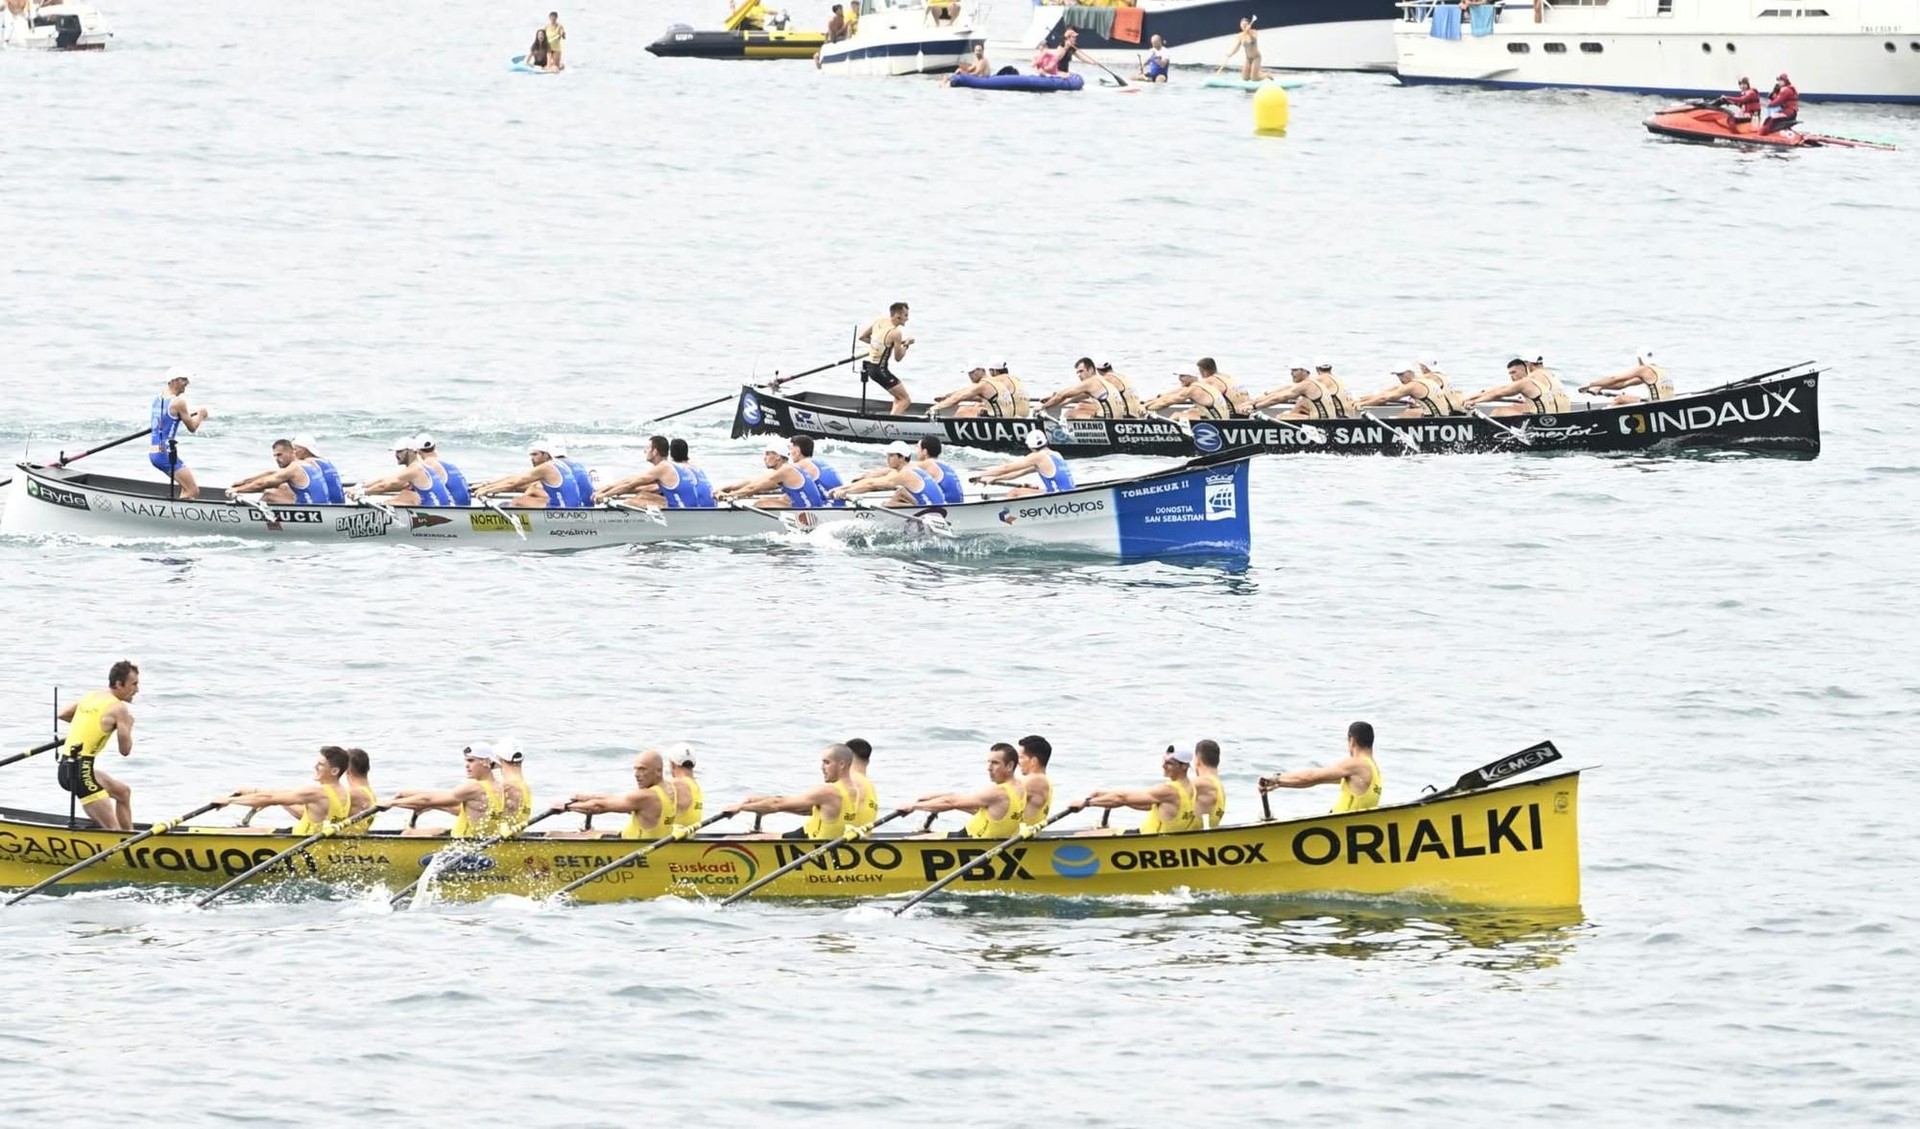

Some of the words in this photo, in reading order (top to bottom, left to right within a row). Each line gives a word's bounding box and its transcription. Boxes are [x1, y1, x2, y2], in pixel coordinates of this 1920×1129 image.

[1650, 388, 1801, 433] INDAUX
[1114, 423, 1179, 434] GETARIA
[1223, 427, 1328, 445] VIVEROS
[1335, 427, 1383, 443] SAN
[1391, 425, 1474, 443] ANTON
[40, 486, 86, 506] Ryde
[121, 502, 170, 517] NAIZ
[172, 506, 241, 522] HOMES
[251, 510, 320, 522] DUCK
[1019, 499, 1105, 518] serviobras
[1155, 506, 1194, 514] DONOSTIA
[470, 514, 530, 525] NORTINL
[1163, 514, 1204, 523] SEBASTIAN
[1478, 747, 1554, 781] KEMEN
[1292, 804, 1543, 865] ORIALKI
[774, 843, 903, 871] INDO
[920, 847, 1036, 882] PBX
[1111, 843, 1268, 870] ORBINOX
[670, 862, 736, 873] Euskadi
[672, 874, 740, 885] LowCost
[809, 874, 884, 883] DELANCHY
